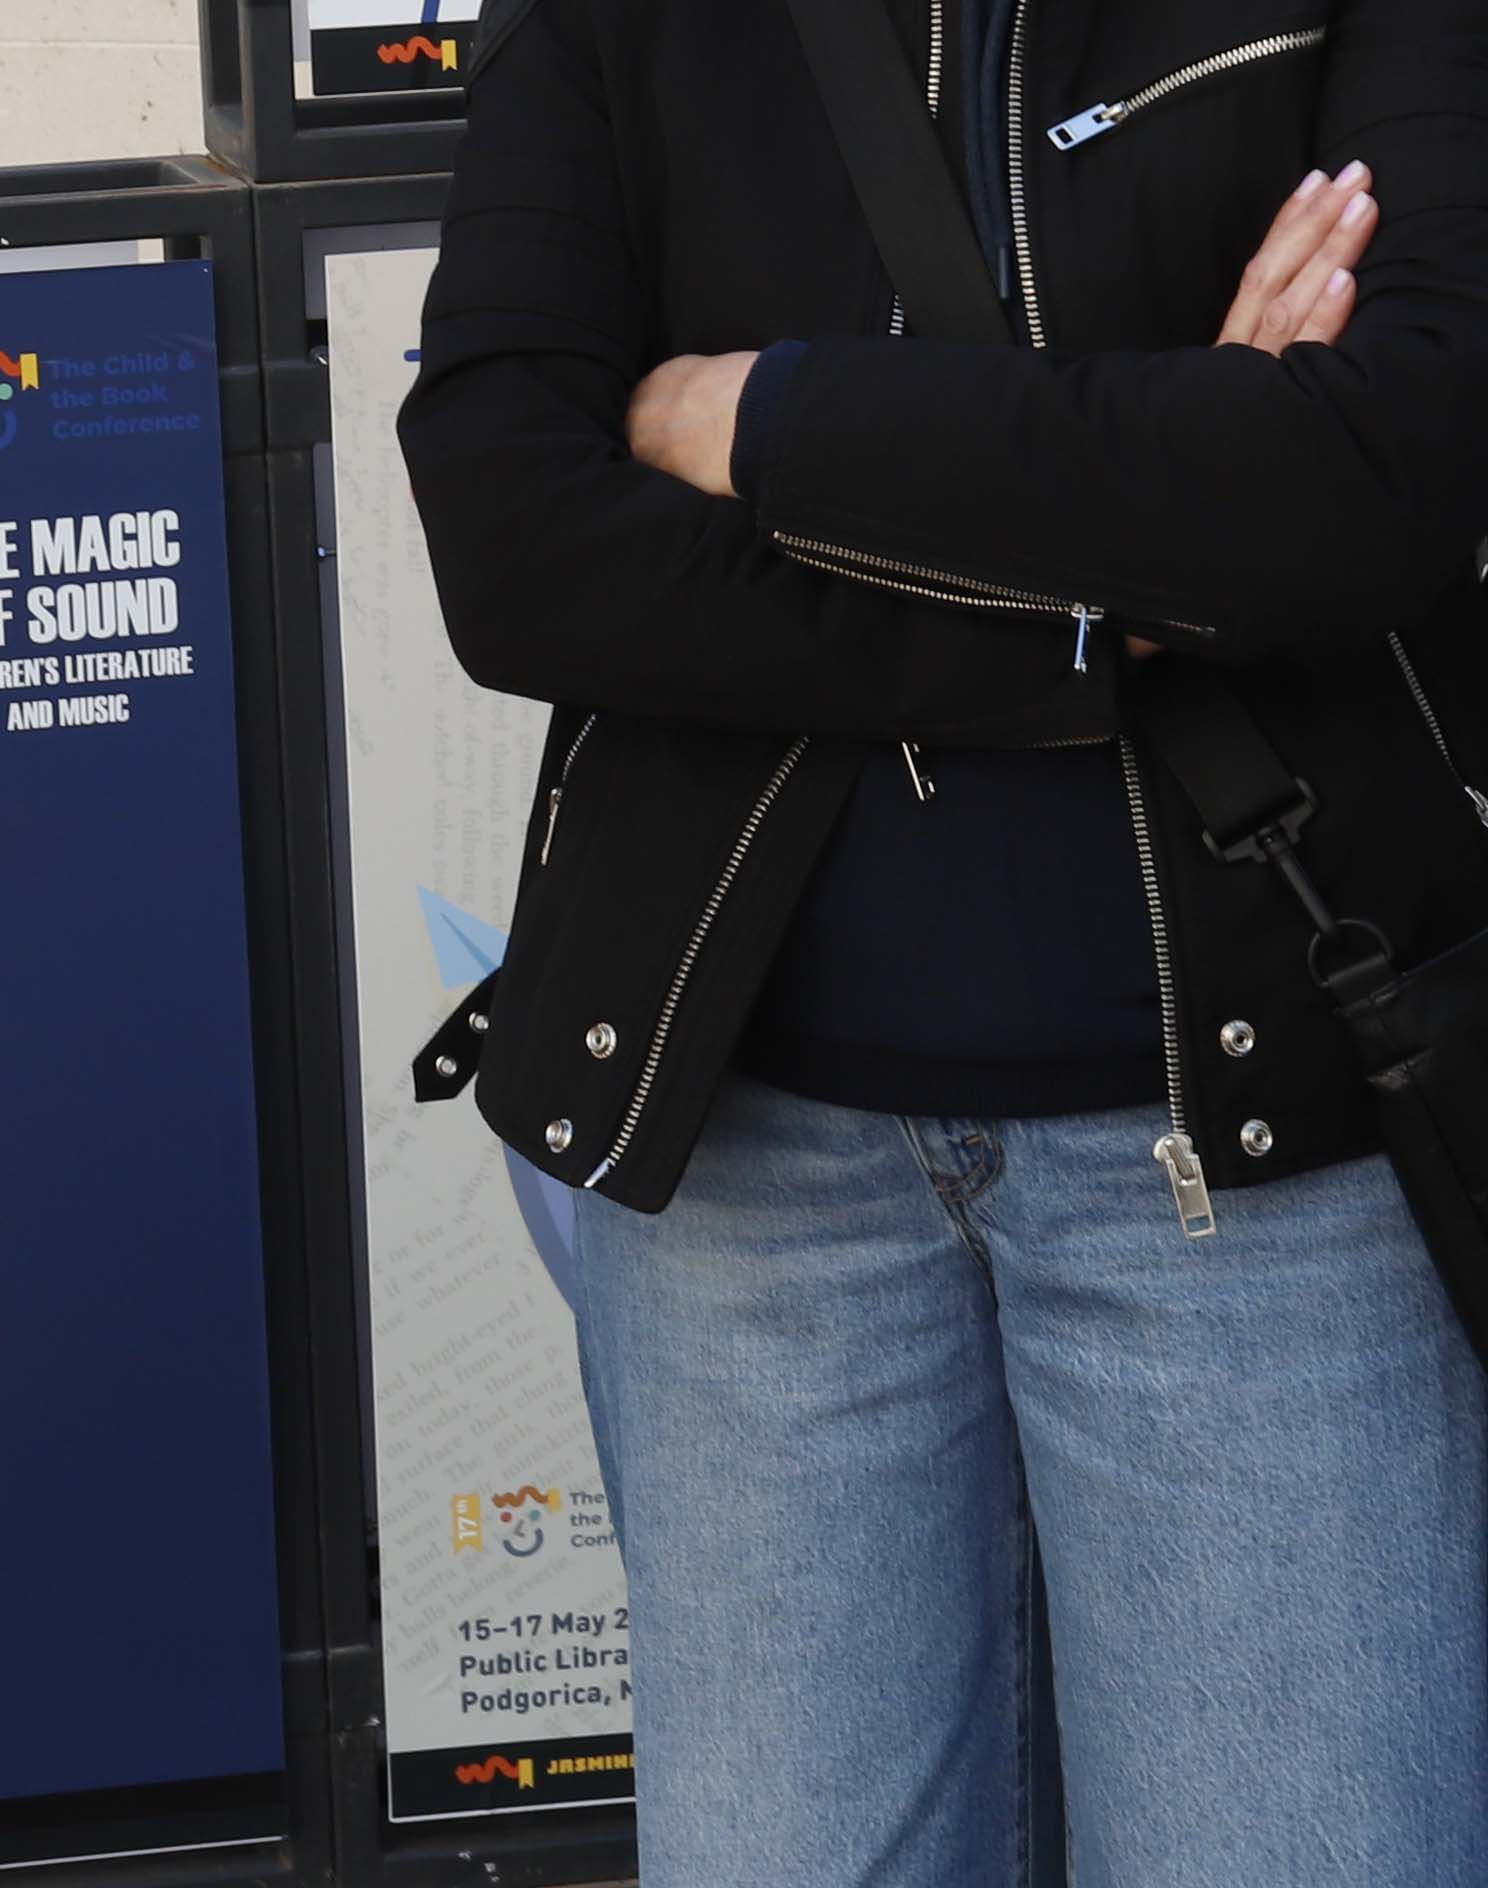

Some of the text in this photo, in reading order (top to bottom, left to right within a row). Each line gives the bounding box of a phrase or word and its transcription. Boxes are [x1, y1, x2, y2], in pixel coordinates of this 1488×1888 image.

[48, 351, 195, 379] The Child &
[50, 382, 169, 409] the Book
[52, 411, 201, 440] Conference
[30, 509, 181, 576] MAGIC
[27, 576, 178, 645] SOUND
[64, 646, 193, 683] LITERATURE
[7, 693, 130, 732] AND MUSIC
[570, 1491, 606, 1508] The
[570, 1511, 602, 1528] the
[551, 1612, 606, 1638] May
[460, 1650, 548, 1678] Public
[556, 1647, 630, 1672] Libra
[461, 1683, 612, 1716] Podgorica,
